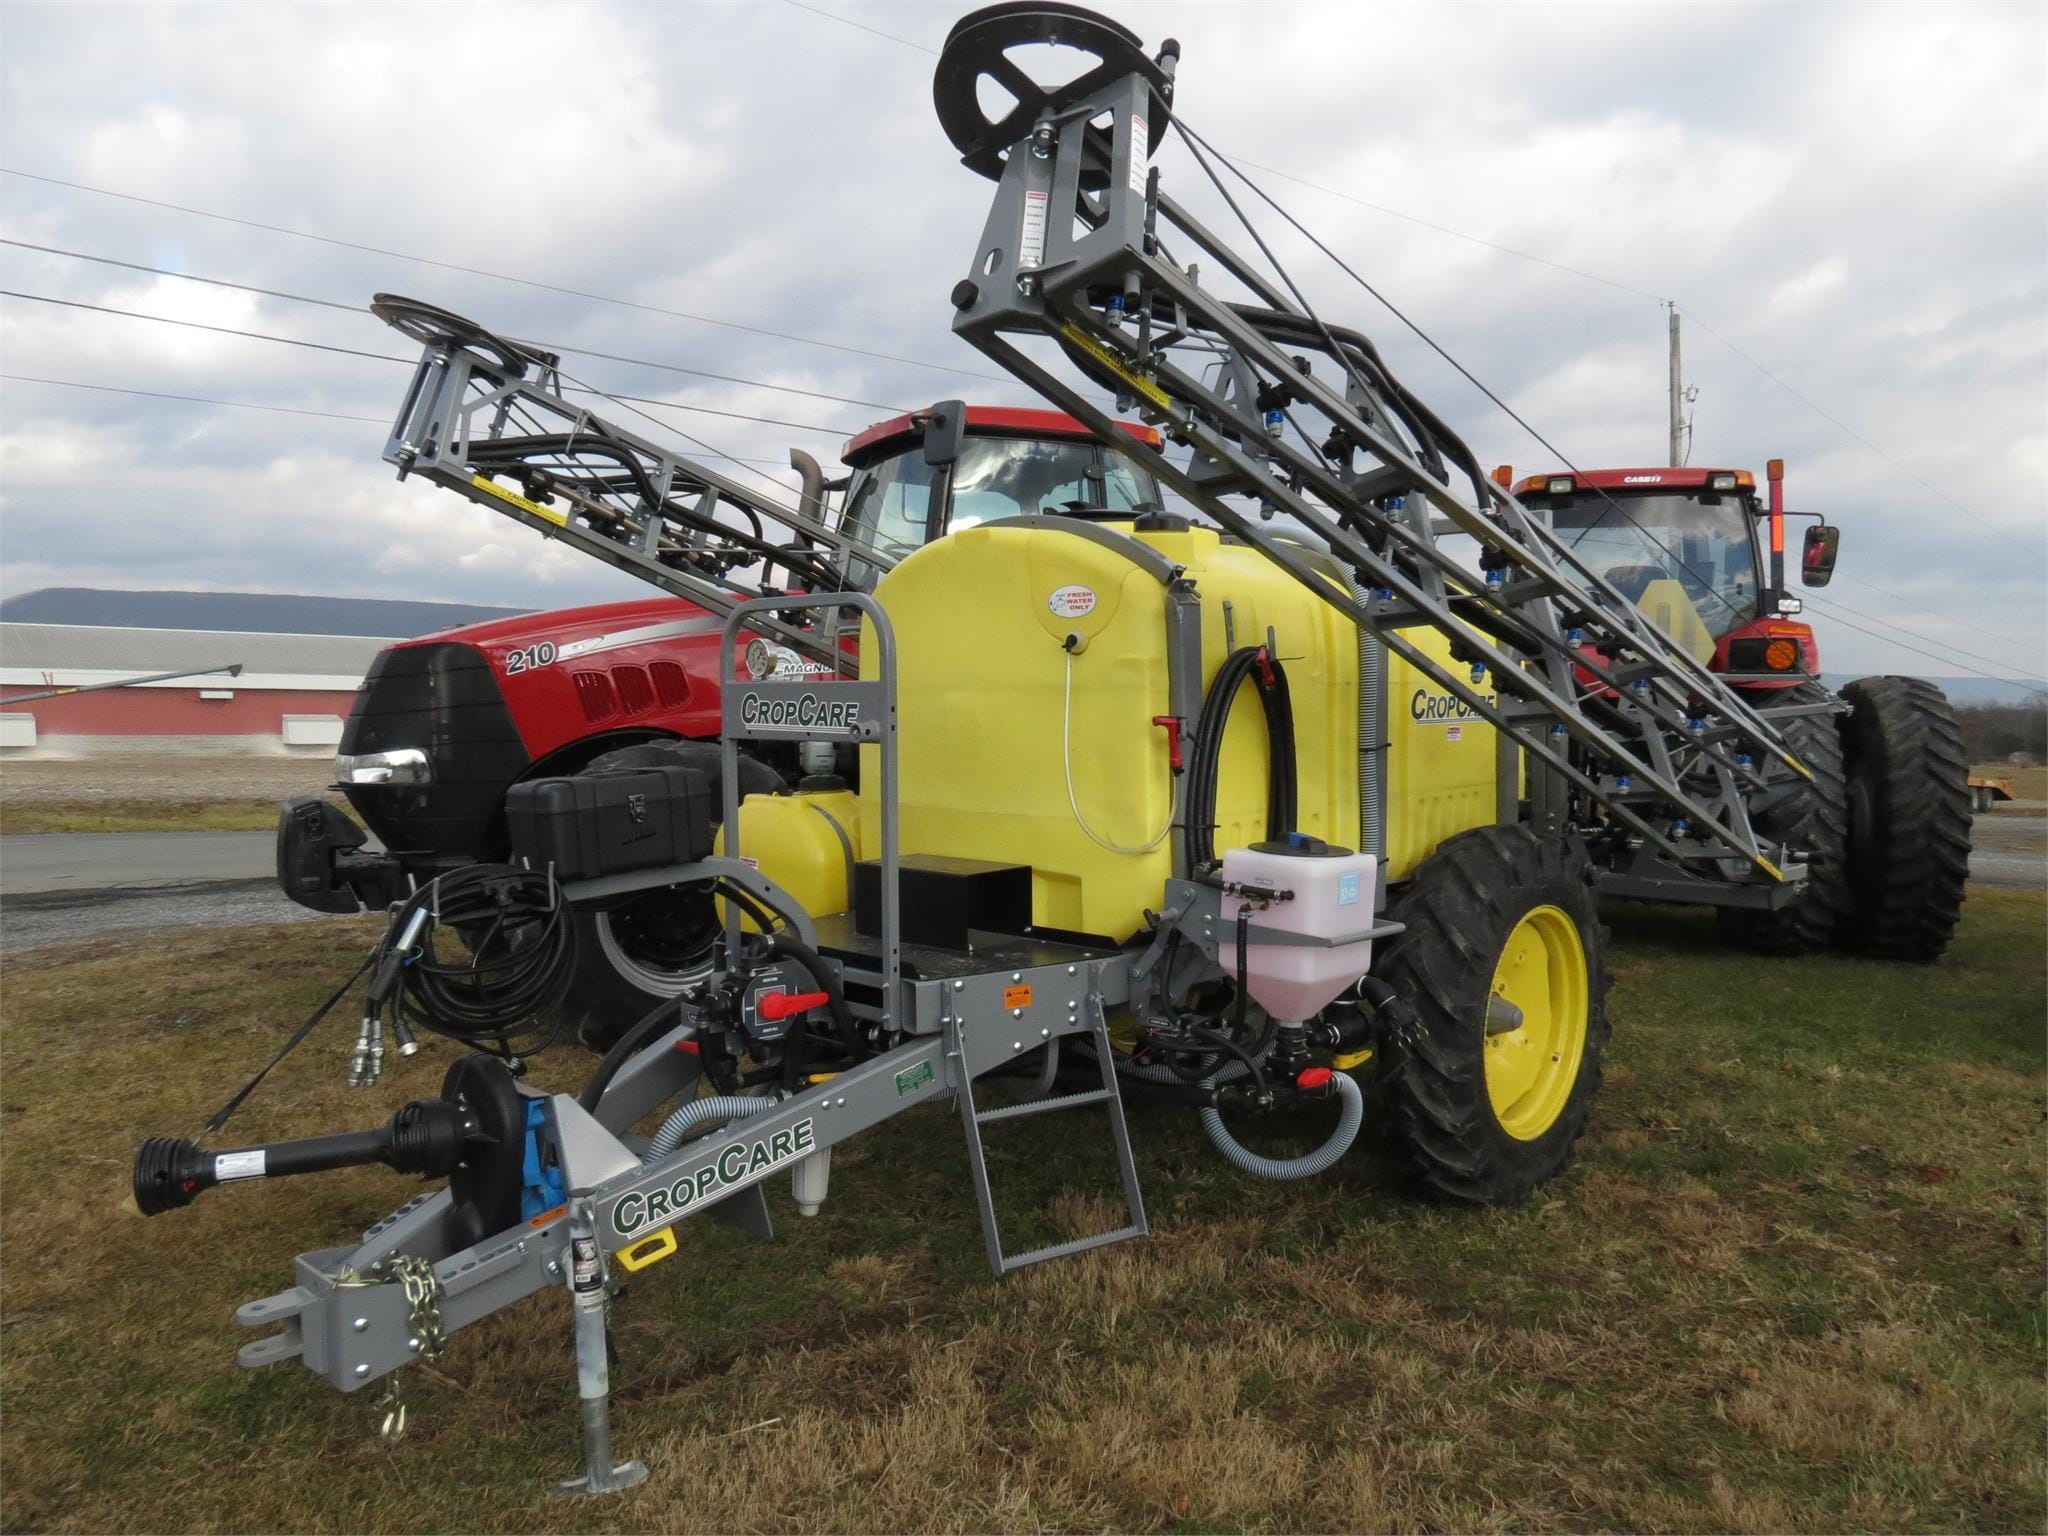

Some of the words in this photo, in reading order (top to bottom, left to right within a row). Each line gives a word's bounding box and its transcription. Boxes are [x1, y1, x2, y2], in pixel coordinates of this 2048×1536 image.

[506, 641, 555, 675] 210
[783, 662, 835, 675] MAGNU
[741, 692, 860, 728] CROPCARE
[612, 1117, 814, 1236] CROPCARE
